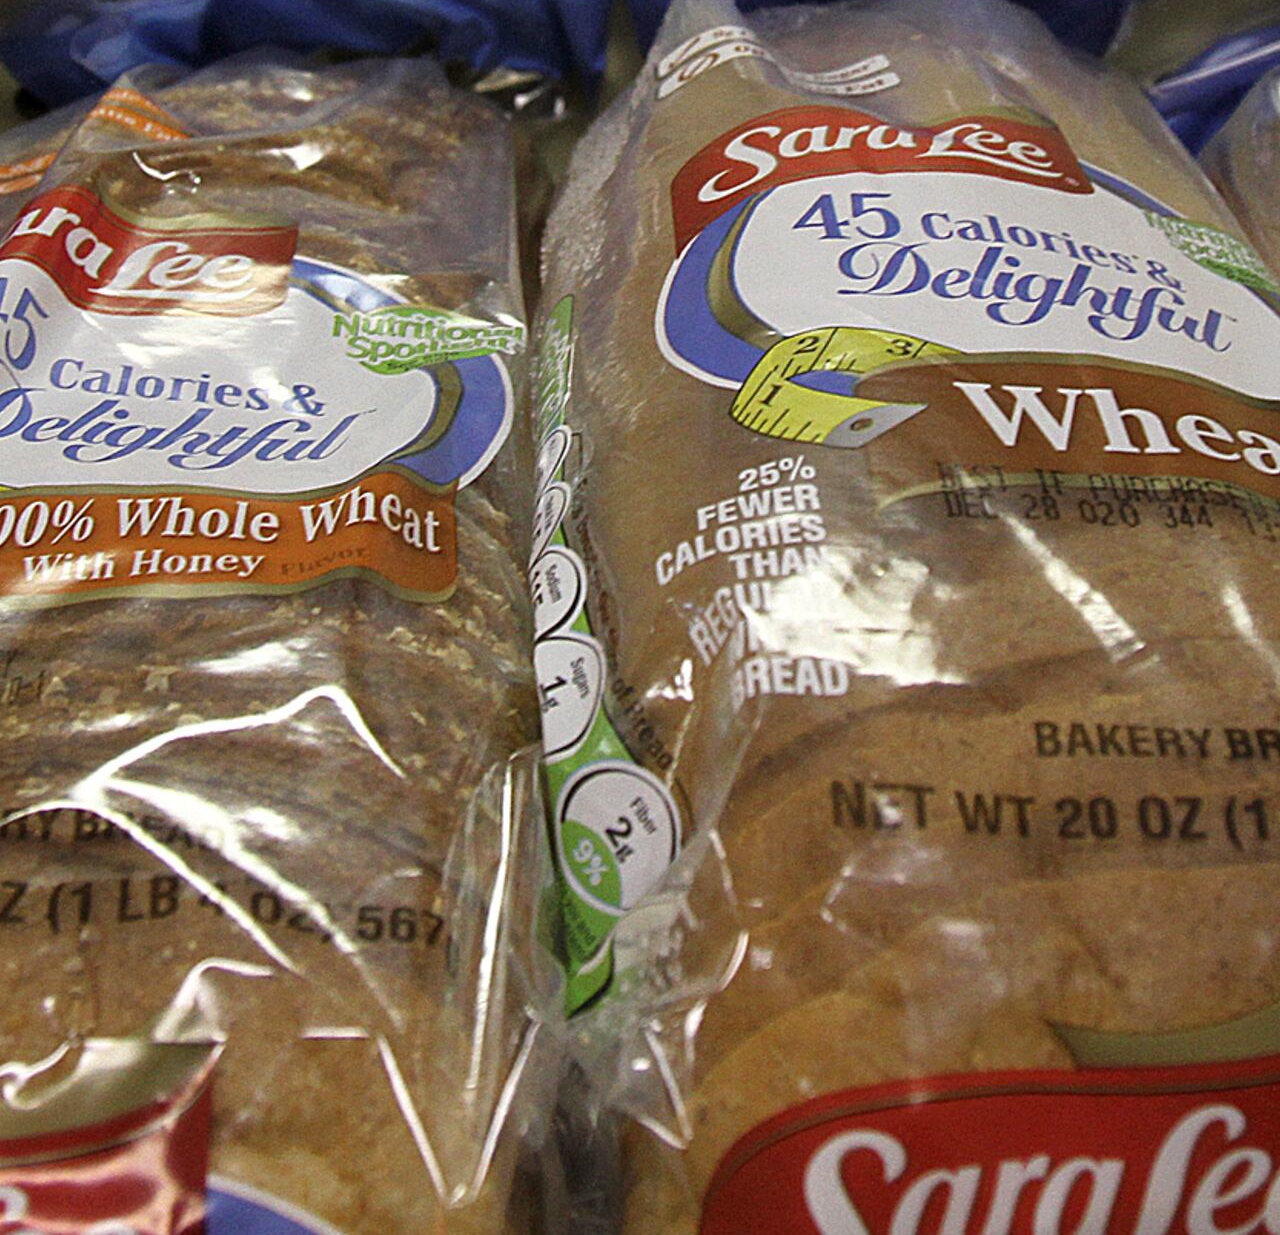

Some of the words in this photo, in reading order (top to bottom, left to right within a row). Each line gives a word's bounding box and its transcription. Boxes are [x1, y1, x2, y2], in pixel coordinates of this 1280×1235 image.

[698, 122, 918, 203] Sara
[918, 121, 1065, 181] Lee
[88, 240, 260, 302] Lee
[793, 192, 902, 241] 45
[920, 210, 1140, 276] Calories
[1143, 258, 1188, 293] &
[836, 241, 1234, 353] Delightful
[49, 358, 273, 412] Calories
[291, 383, 327, 417] &
[738, 454, 816, 492] 25%
[116, 494, 280, 544] Whole
[300, 483, 443, 554] Wheat
[696, 483, 821, 531] FEWER
[944, 489, 998, 521] DEC
[1022, 493, 1062, 521] 28
[1077, 497, 1141, 529] 020
[22, 550, 116, 583] With
[127, 546, 265, 579] Honey
[655, 514, 827, 586] CALORIES
[728, 546, 823, 580] THAN
[1033, 720, 1214, 761] BAKERY
[628, 795, 658, 838] Fiber
[831, 781, 935, 832] NET
[954, 791, 1035, 838] WT
[1055, 797, 1118, 842] 20
[1139, 796, 1208, 843] OZ
[1225, 799, 1271, 851] (1
[46, 884, 93, 932] (1
[119, 875, 180, 921] LB
[355, 903, 448, 946] 567
[803, 1129, 1125, 1235] Sara
